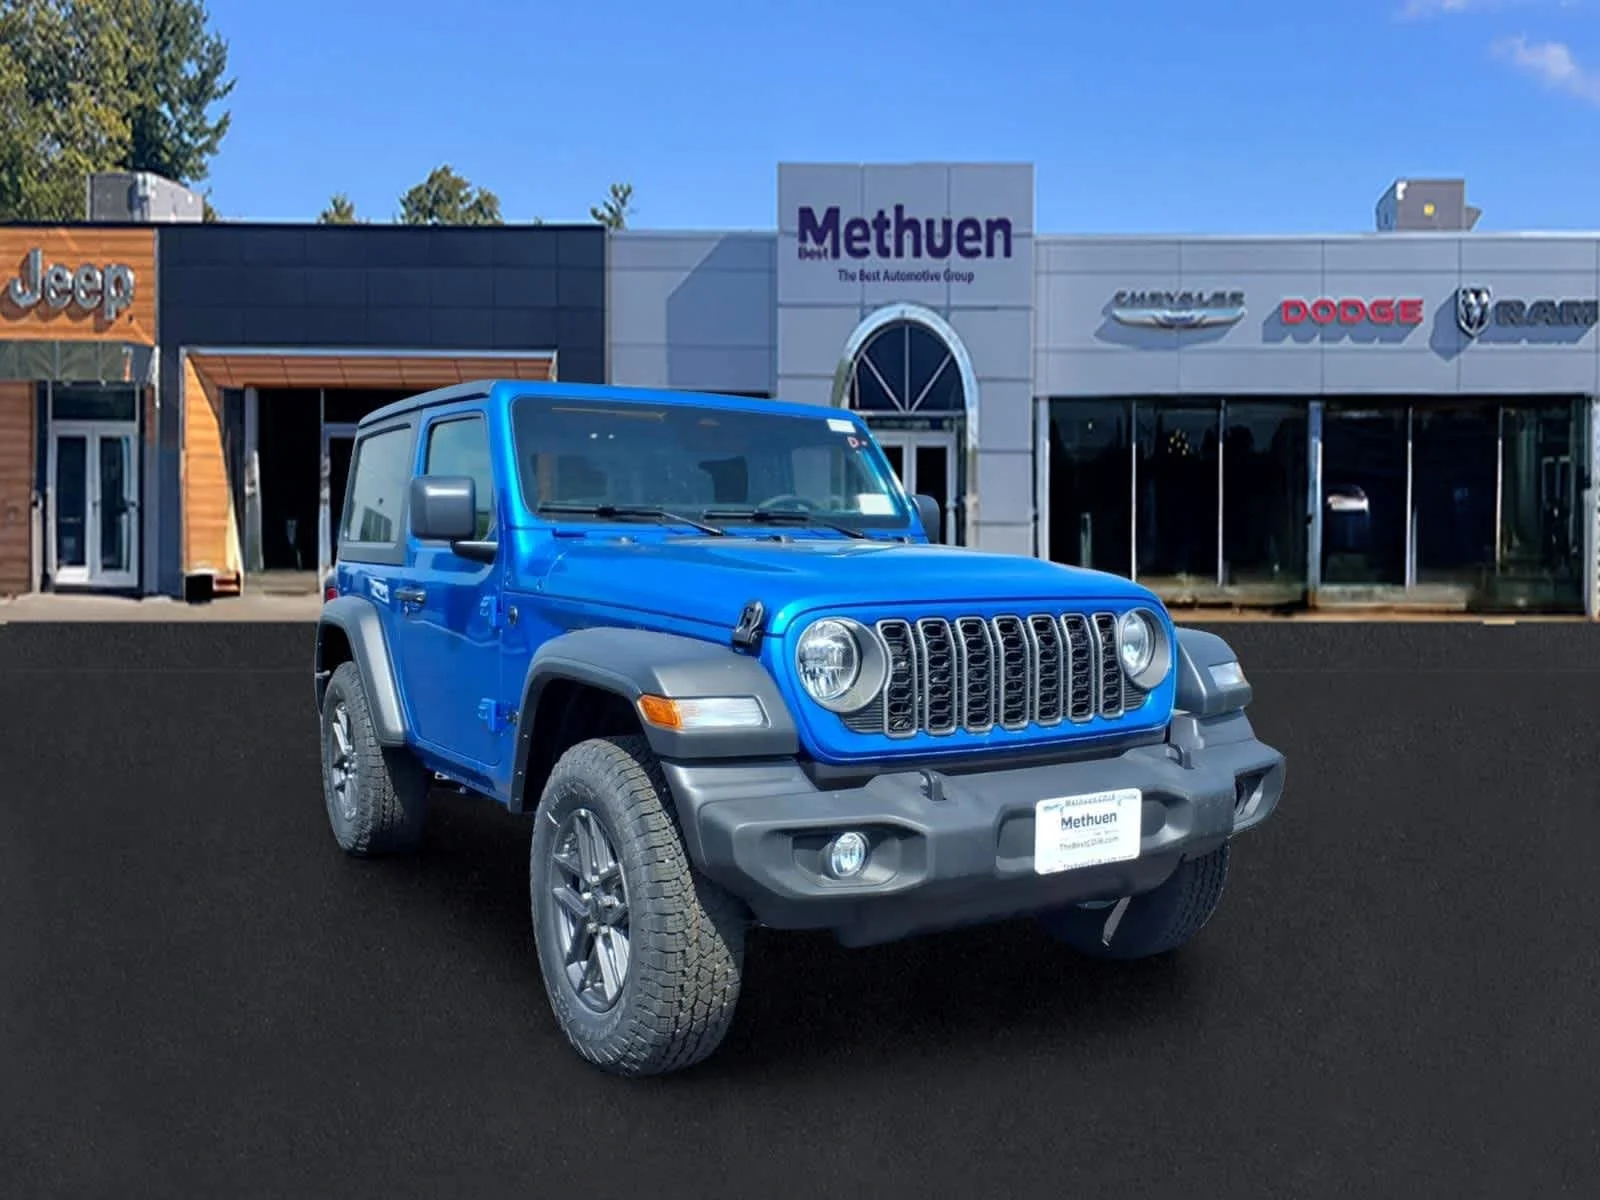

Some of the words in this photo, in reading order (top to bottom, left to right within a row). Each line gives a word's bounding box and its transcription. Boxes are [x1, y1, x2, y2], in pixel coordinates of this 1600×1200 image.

[798, 204, 1012, 260] Methuen
[8, 248, 135, 321] Jeep
[838, 269, 857, 282] The
[859, 269, 880, 282] Best
[883, 269, 941, 282] Automotive
[943, 269, 975, 284] Group
[1281, 298, 1424, 325] DODGE
[1496, 299, 1599, 326] RAM
[1061, 812, 1117, 830] Methuen
